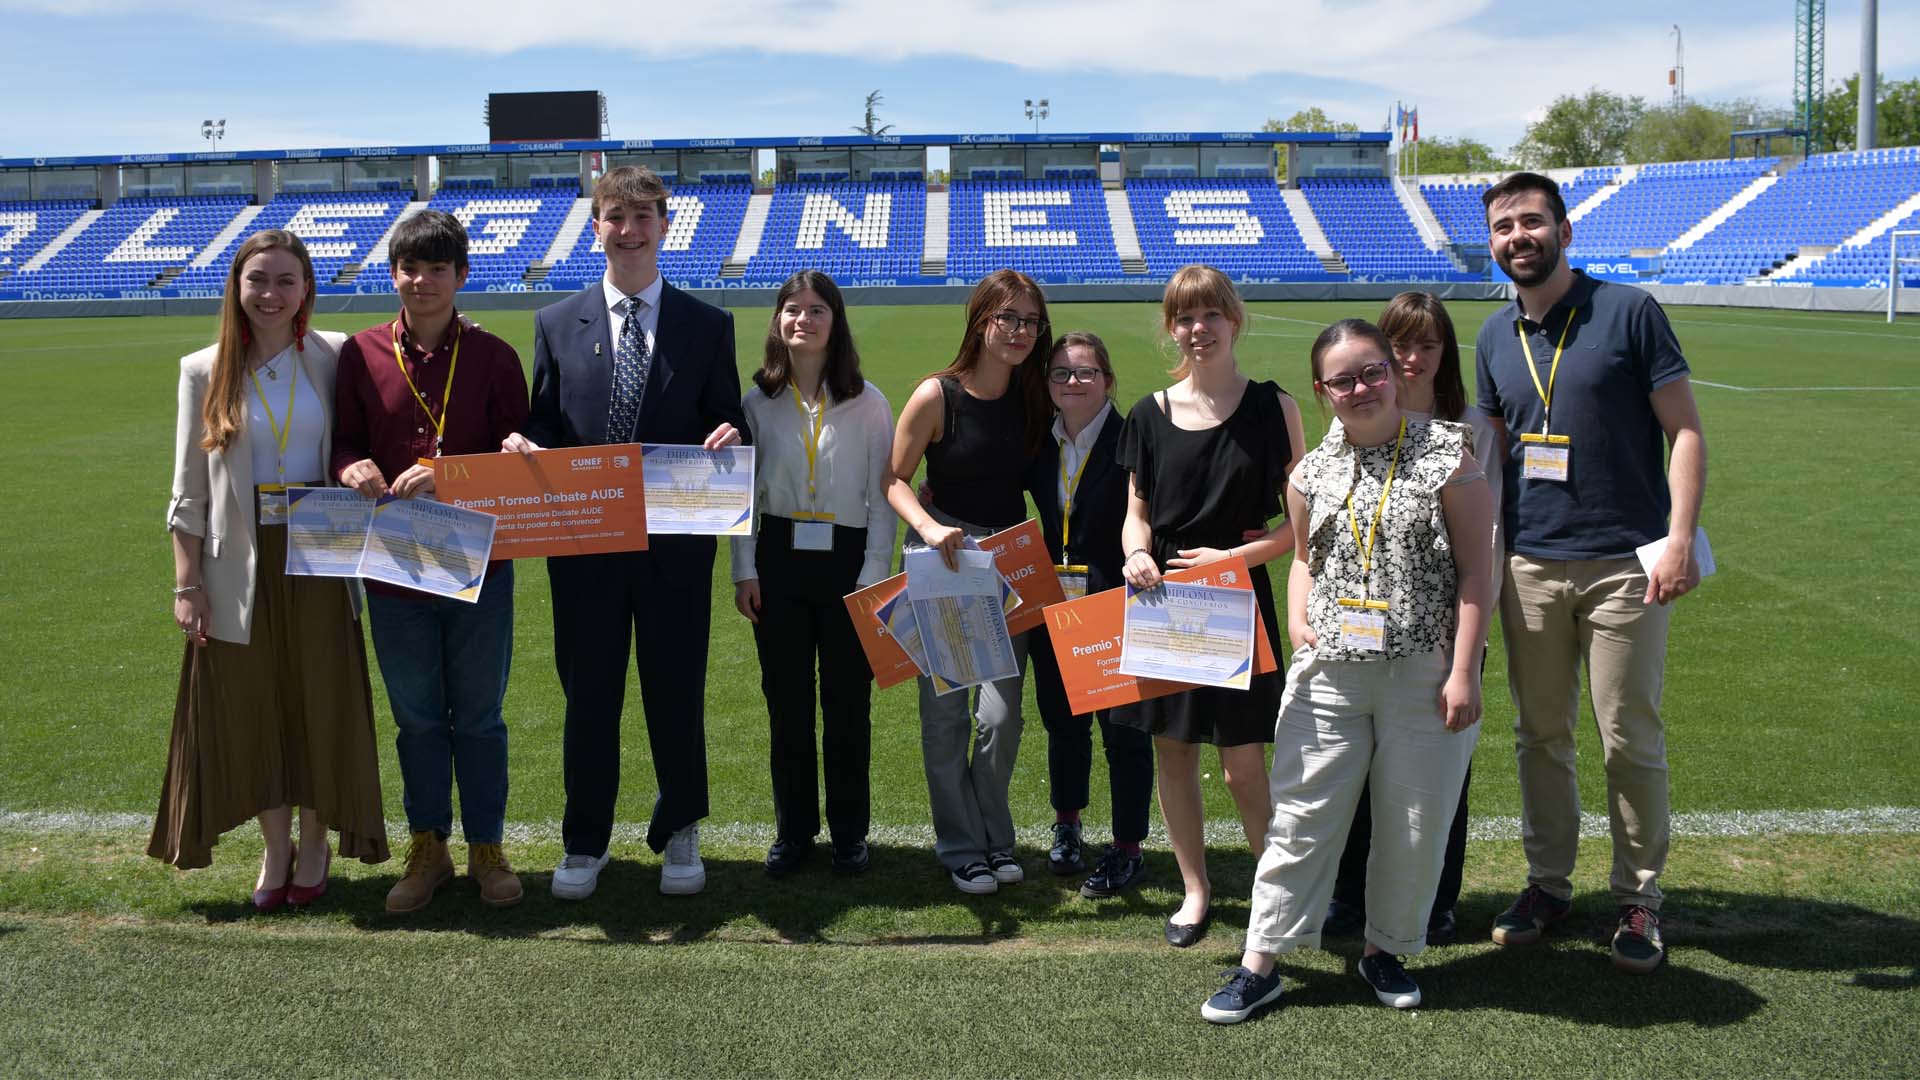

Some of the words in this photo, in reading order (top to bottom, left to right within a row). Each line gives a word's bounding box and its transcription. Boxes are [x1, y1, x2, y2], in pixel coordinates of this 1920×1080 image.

[571, 457, 602, 467] CUNEF
[453, 497, 496, 508] Premio
[498, 495, 541, 506] Torneo
[543, 490, 587, 503] Debate
[590, 488, 625, 500] AUDE
[1072, 640, 1113, 657] Premio
